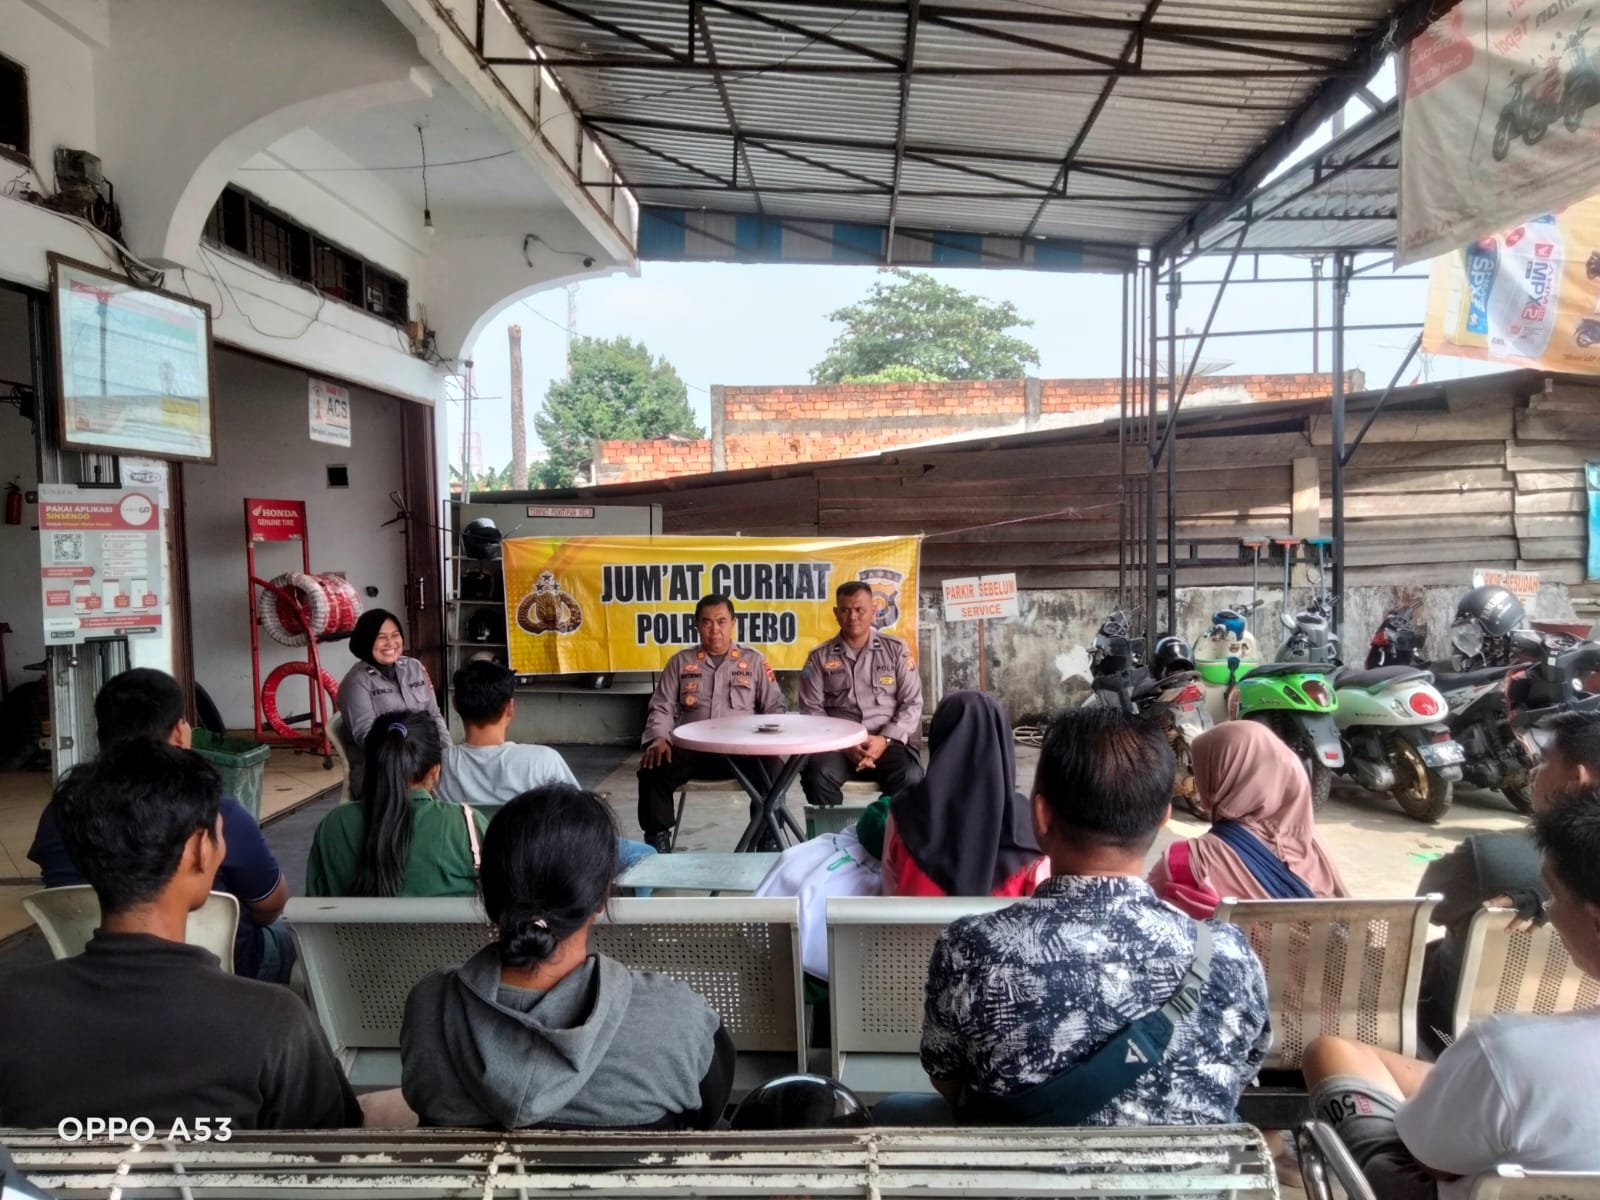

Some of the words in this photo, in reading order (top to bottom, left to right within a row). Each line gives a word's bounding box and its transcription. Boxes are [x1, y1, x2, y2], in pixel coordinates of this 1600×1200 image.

[327, 397, 348, 419] ACS
[262, 509, 299, 518] HONDA
[601, 564, 704, 602] JUM'AT
[711, 563, 831, 601] CURHAT
[945, 583, 974, 600] PARKIR
[979, 580, 1015, 597] SEBELUM
[961, 604, 1002, 618] SERVICE
[637, 613, 699, 644] POLR
[735, 612, 796, 643] TEBO
[1324, 1094, 1357, 1127] 501
